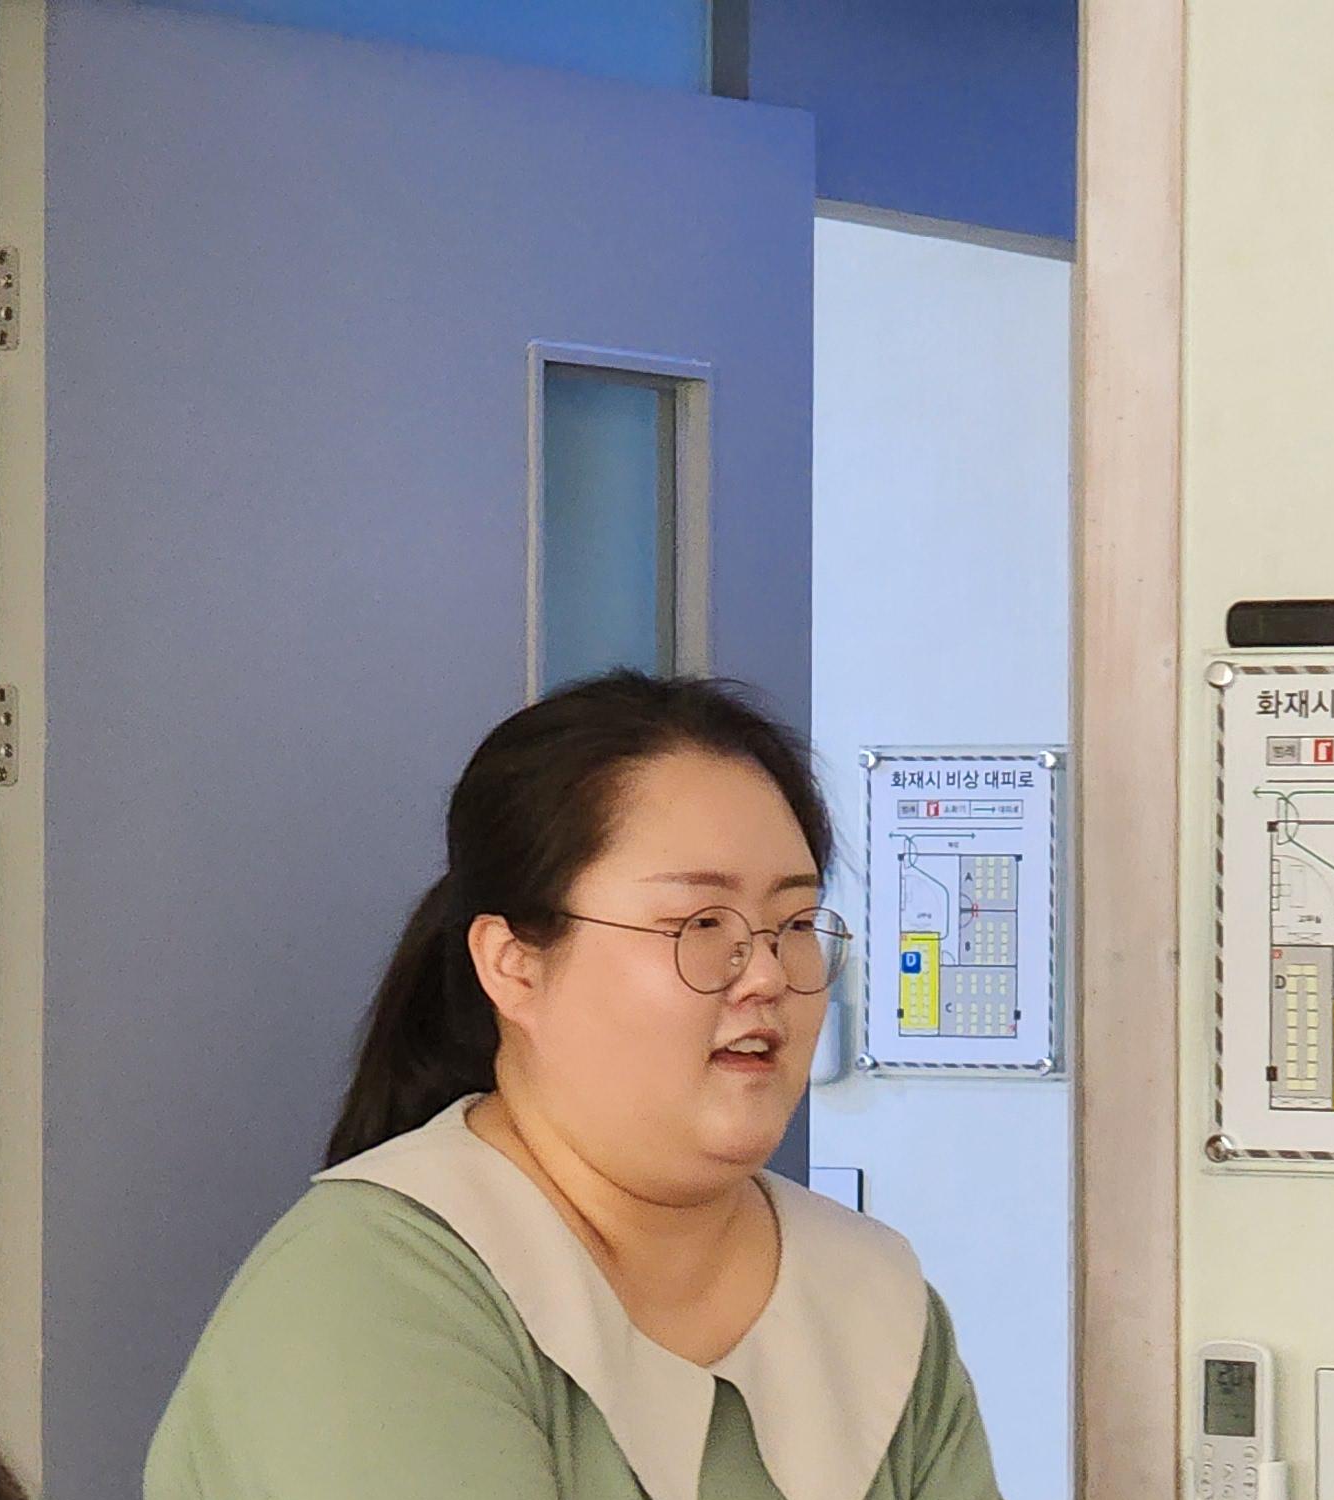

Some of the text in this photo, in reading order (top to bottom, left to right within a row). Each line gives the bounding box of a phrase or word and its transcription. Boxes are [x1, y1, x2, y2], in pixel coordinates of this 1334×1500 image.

[890, 769, 1035, 790] 화재시 비상 대피로
[964, 871, 973, 882] A
[906, 952, 917, 967] D
[1274, 975, 1287, 990] D
